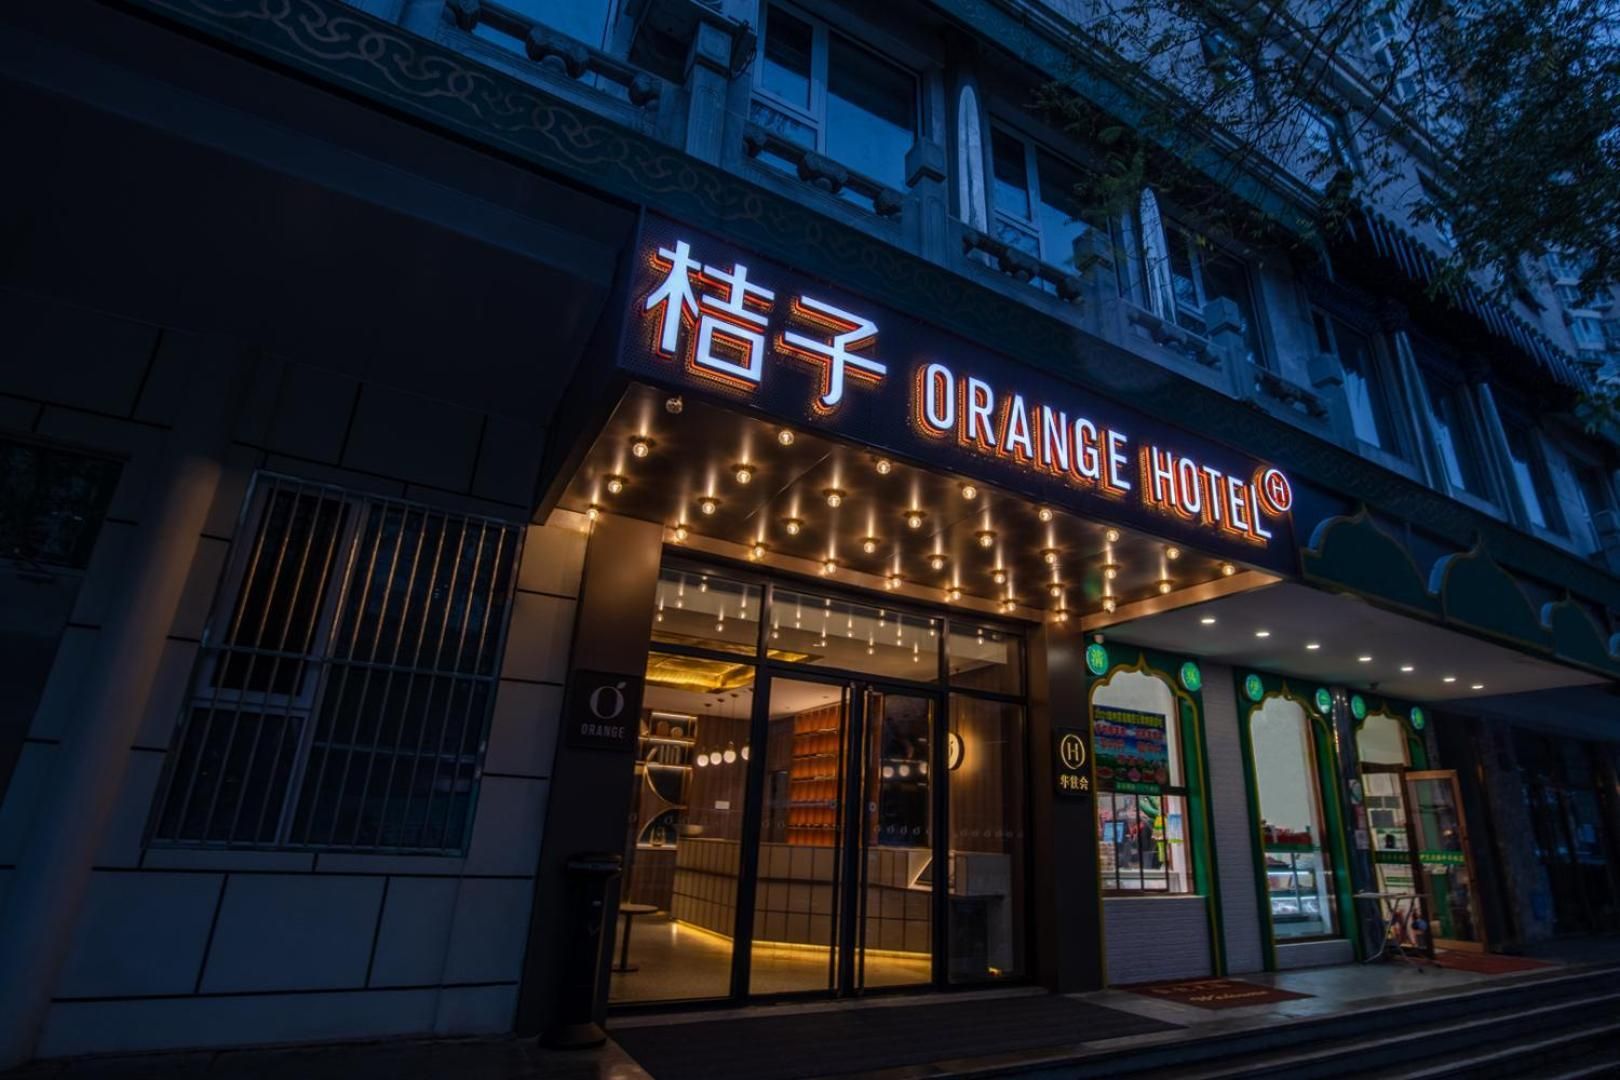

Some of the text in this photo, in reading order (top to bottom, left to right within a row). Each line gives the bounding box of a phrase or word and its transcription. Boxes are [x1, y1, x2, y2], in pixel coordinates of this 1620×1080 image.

[646, 240, 888, 407] 桔子
[925, 363, 1273, 540] ORANGE HOTEL
[580, 722, 625, 739] ORANGE
